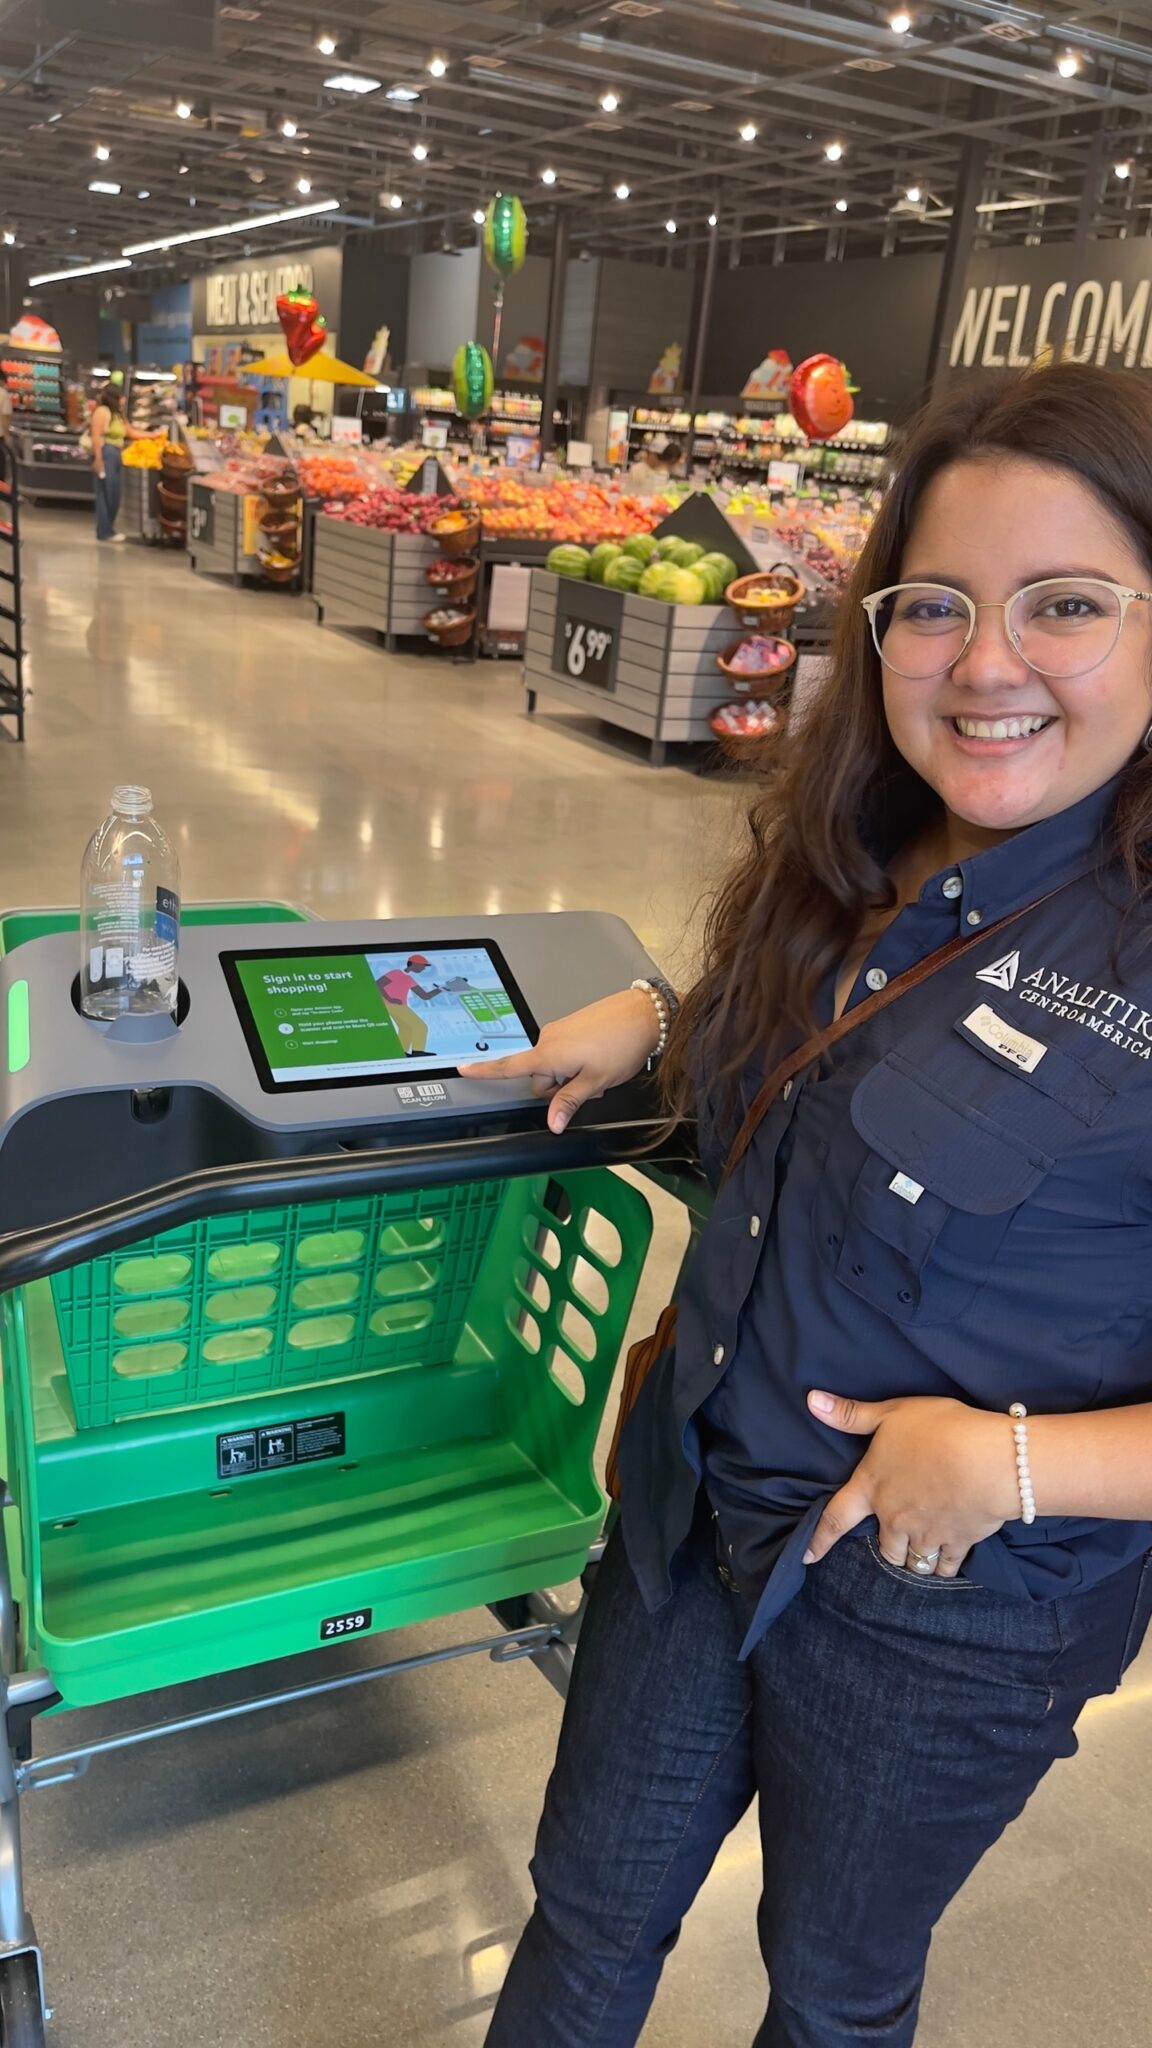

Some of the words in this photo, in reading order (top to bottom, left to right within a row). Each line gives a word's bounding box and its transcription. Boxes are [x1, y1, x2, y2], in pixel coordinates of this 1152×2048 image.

[263, 974, 291, 985] Sign
[293, 973, 306, 982] in
[308, 972, 322, 981] to
[324, 971, 353, 980] start
[266, 983, 328, 995] shopping!
[1019, 989, 1152, 1060] CENTROAMÉRICA
[988, 1022, 1033, 1057] Columbia
[998, 1043, 1028, 1064] PFG
[401, 1097, 422, 1105] SCAN
[325, 1615, 365, 1635] 2559
